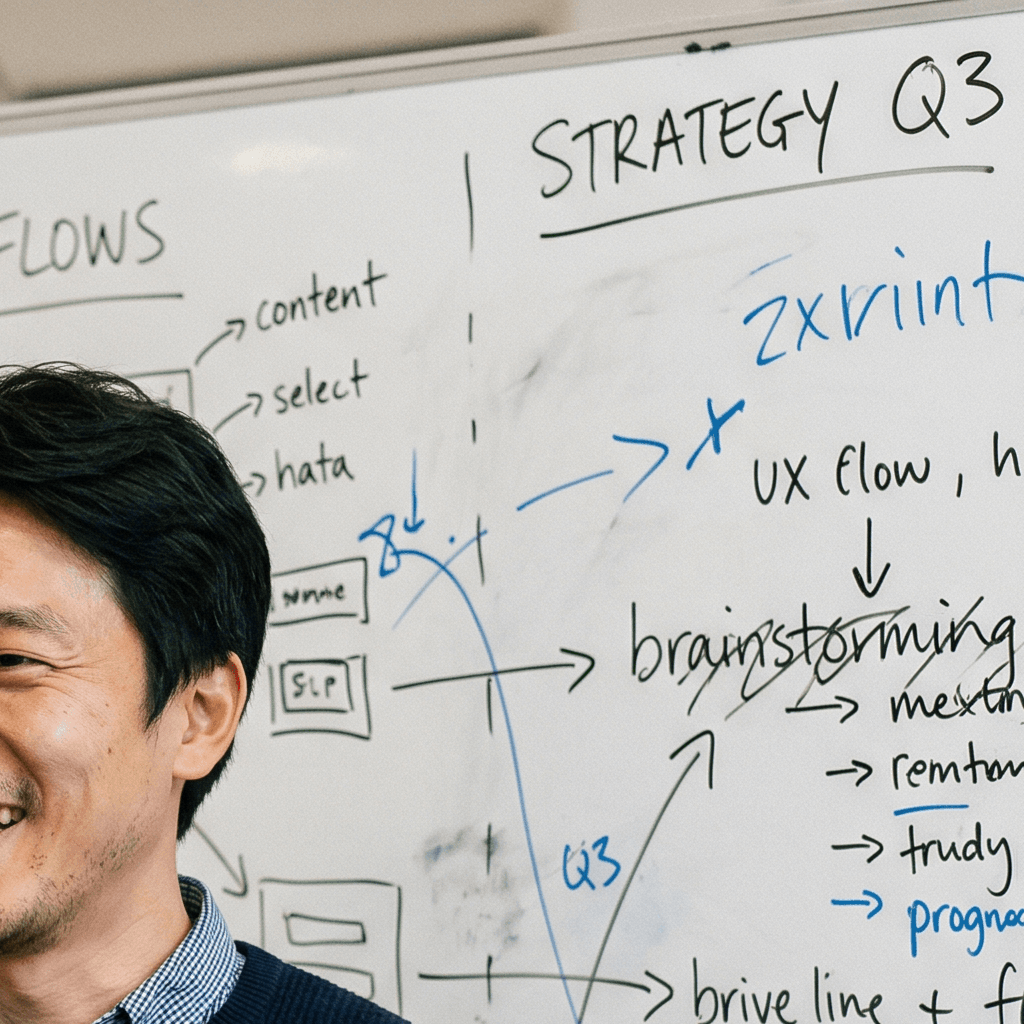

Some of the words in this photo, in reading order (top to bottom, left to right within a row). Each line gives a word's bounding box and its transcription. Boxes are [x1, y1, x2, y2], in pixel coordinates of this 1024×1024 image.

[532, 79, 839, 199] STRATEGY
[891, 50, 1004, 139] Q3
[256, 260, 388, 332] content
[273, 358, 369, 413] select
[275, 449, 355, 491] hata
[753, 454, 810, 506] UX
[631, 600, 1017, 688] brainstorming
[562, 835, 621, 891] Q3
[899, 821, 1013, 897] trudy
